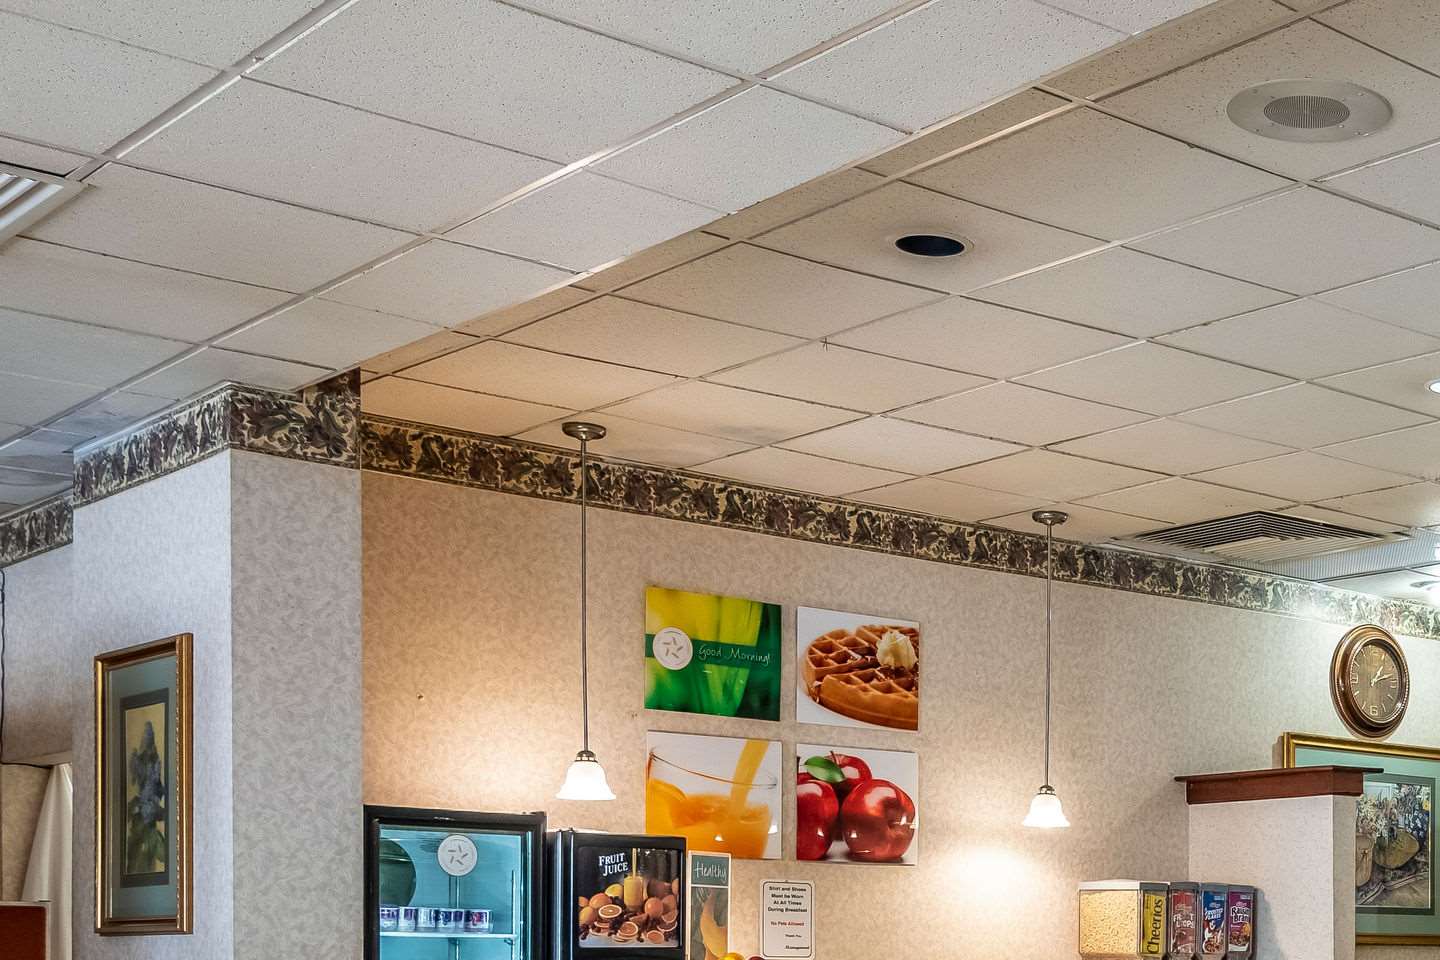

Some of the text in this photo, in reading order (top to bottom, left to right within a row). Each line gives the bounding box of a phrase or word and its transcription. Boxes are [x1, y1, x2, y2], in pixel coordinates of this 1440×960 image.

[698, 643, 771, 666] Good Morning!
[598, 852, 625, 867] FRUIT
[602, 861, 629, 877] JUICE
[693, 860, 727, 884] Healthy
[1146, 898, 1163, 954] Cheerios
